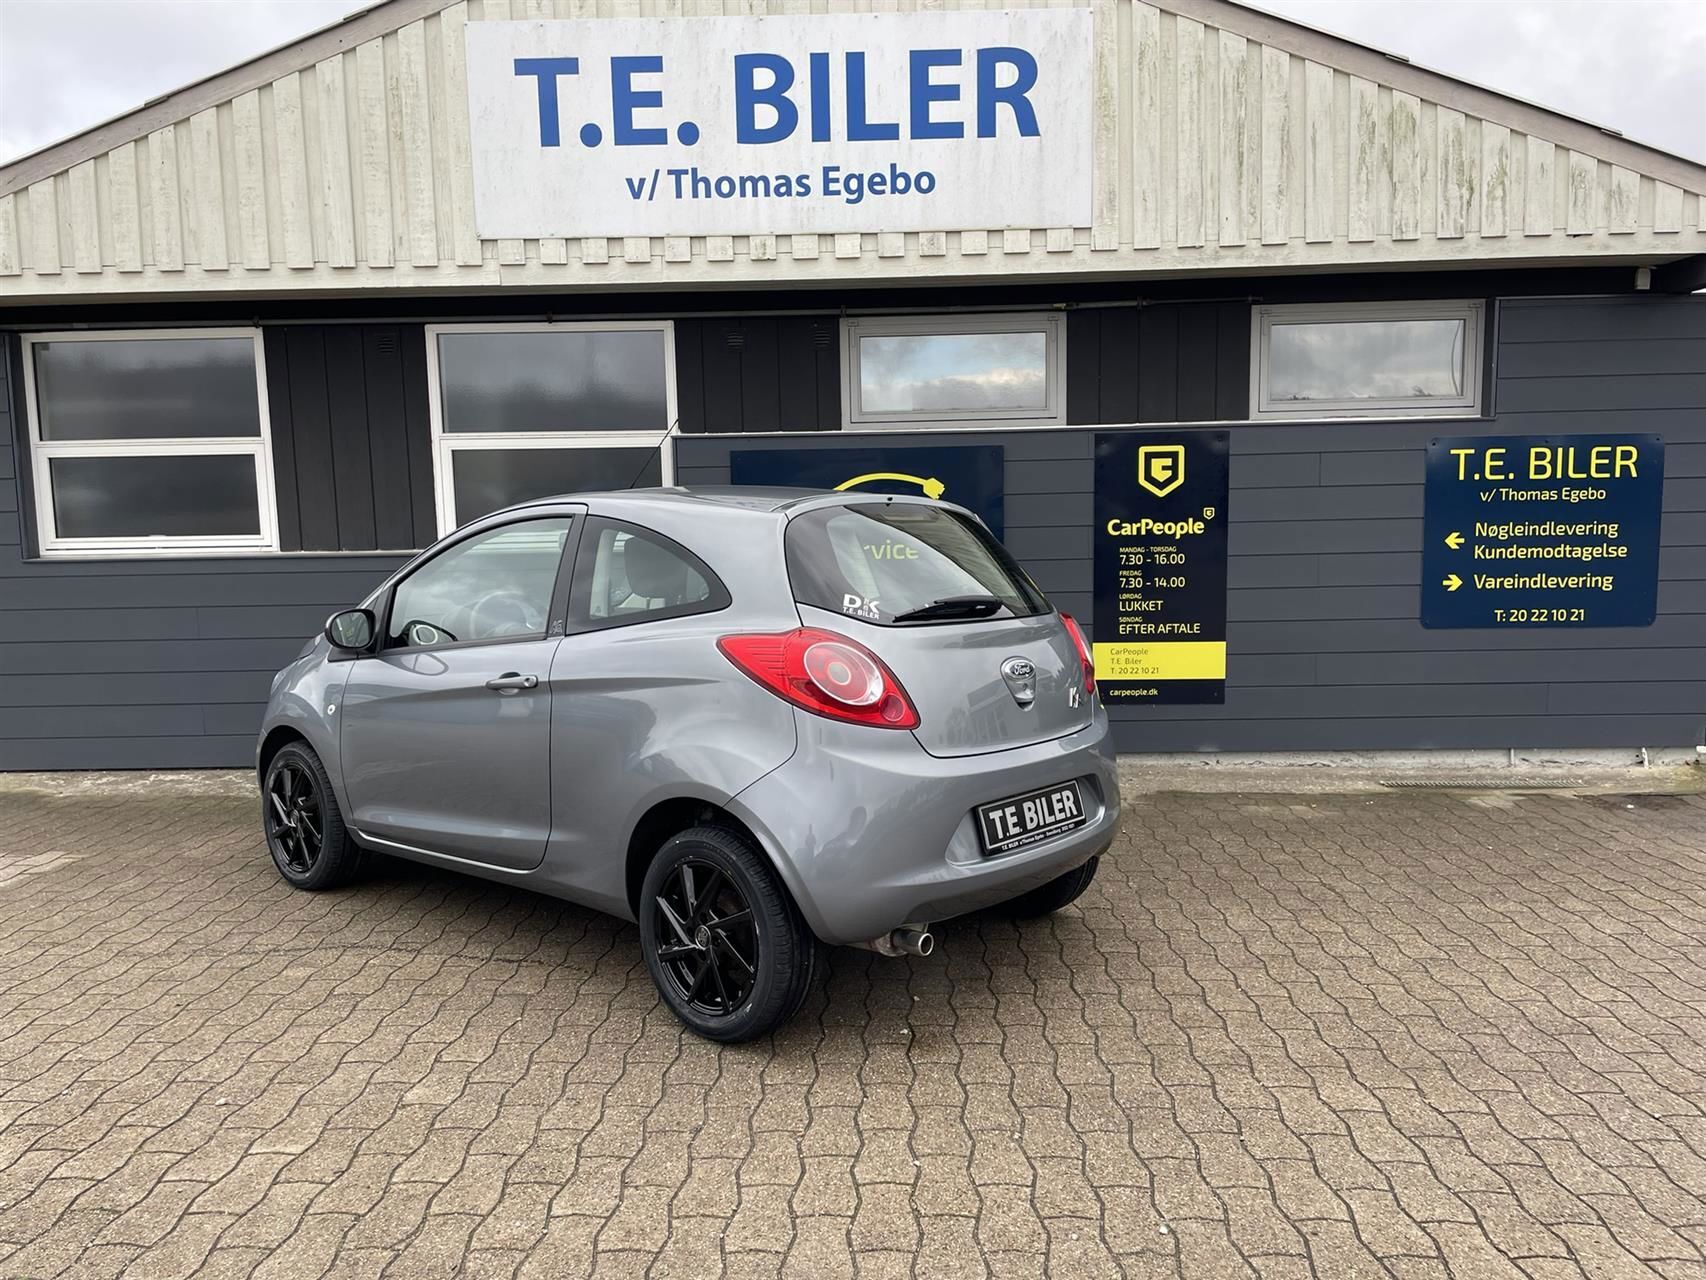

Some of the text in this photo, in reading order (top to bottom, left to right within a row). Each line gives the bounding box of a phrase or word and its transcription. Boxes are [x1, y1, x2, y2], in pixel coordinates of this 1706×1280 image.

[515, 48, 1039, 147] T.E. BILER
[626, 163, 935, 204] v/ Thomas Egebo
[1450, 446, 1637, 480] T.E. BILER
[1480, 487, 1606, 502] v/ Thomas Egebo
[1107, 517, 1205, 540] CarPeople
[1476, 521, 1618, 539] Nøgleindlevering
[1120, 555, 1143, 565] 7.30
[1155, 554, 1185, 564] 16.00
[1475, 543, 1627, 561] Kundemodtagelse
[1120, 578, 1142, 588] 7.30
[1154, 577, 1185, 587] 14.00
[1474, 573, 1613, 591] Vareindlevering
[1120, 601, 1163, 611] LUKKET
[1495, 609, 1584, 621] T: 20 22 10 21
[1120, 623, 1200, 634] EFTER AFTALE
[1110, 648, 1149, 656] CarPeople
[1109, 688, 1160, 697] carpeople.dk
[1022, 789, 1078, 831] BILER
